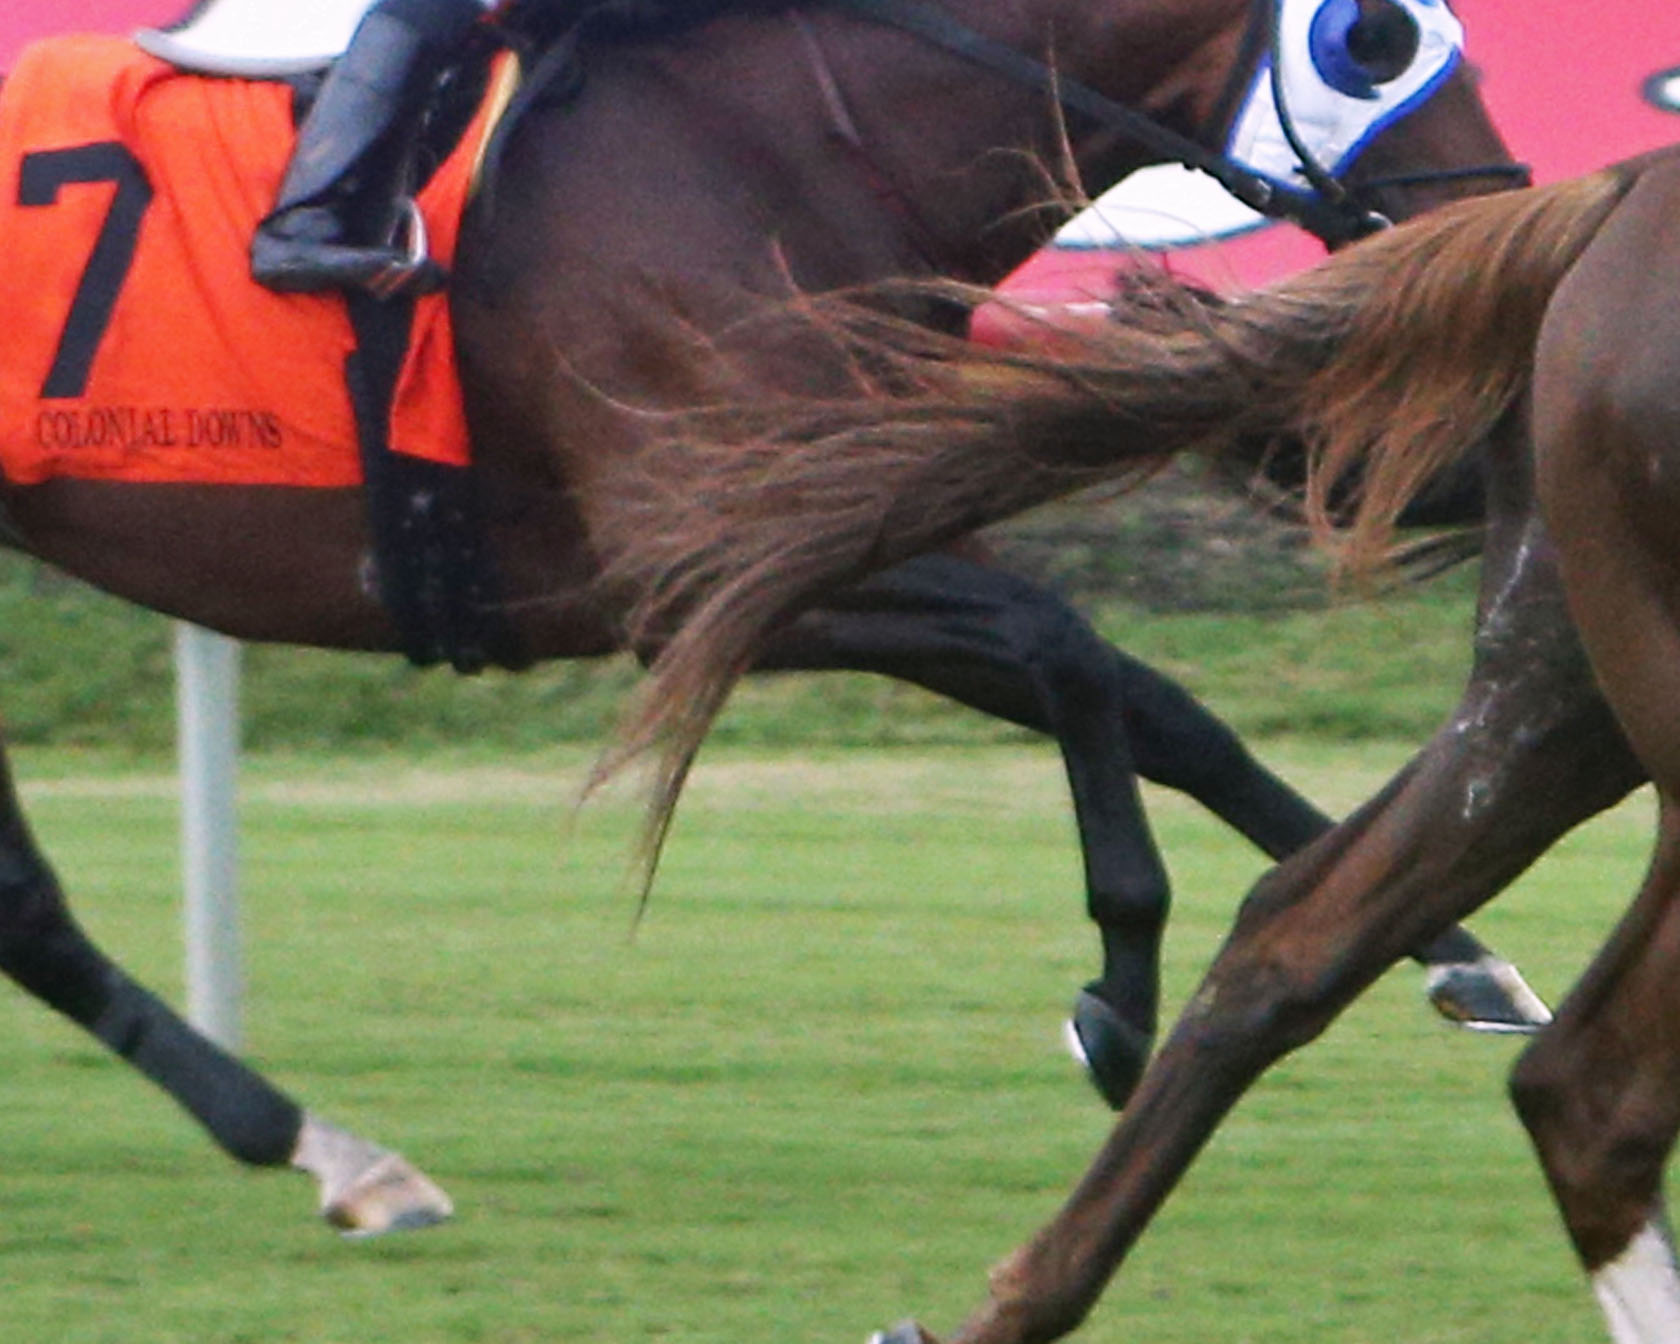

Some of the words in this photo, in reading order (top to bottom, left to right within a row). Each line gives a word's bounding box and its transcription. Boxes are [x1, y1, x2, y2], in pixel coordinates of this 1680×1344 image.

[17, 141, 154, 399] 7
[37, 406, 177, 448] COLONIAL
[186, 408, 283, 449] DOWNS
